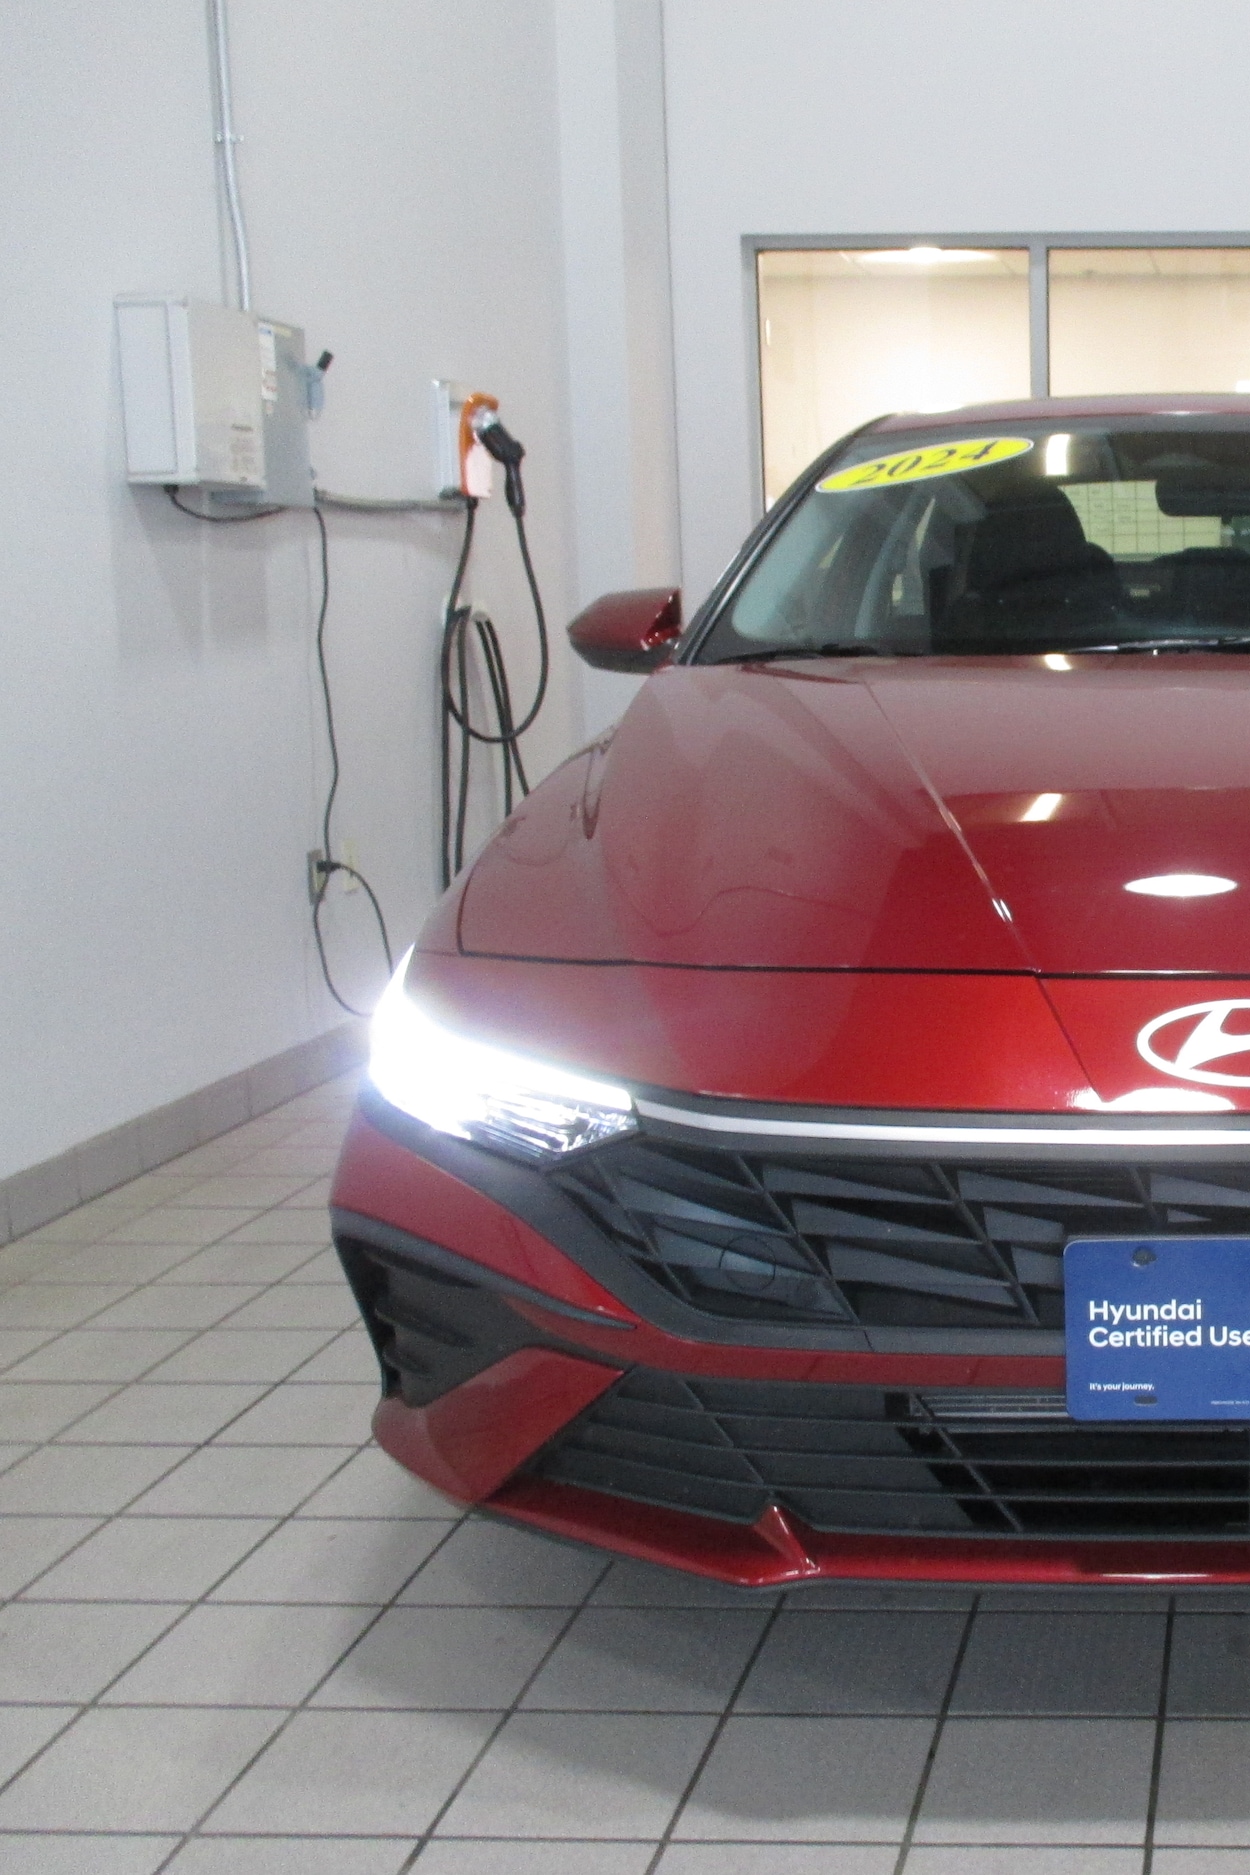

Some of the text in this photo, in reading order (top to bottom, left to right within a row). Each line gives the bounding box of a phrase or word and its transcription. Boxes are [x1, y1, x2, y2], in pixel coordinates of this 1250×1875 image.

[849, 440, 998, 486] 2024
[1089, 1299, 1202, 1325] Hyundai
[1089, 1325, 1202, 1348] Certified
[1089, 1382, 1102, 1391] It's
[1103, 1383, 1121, 1392] your
